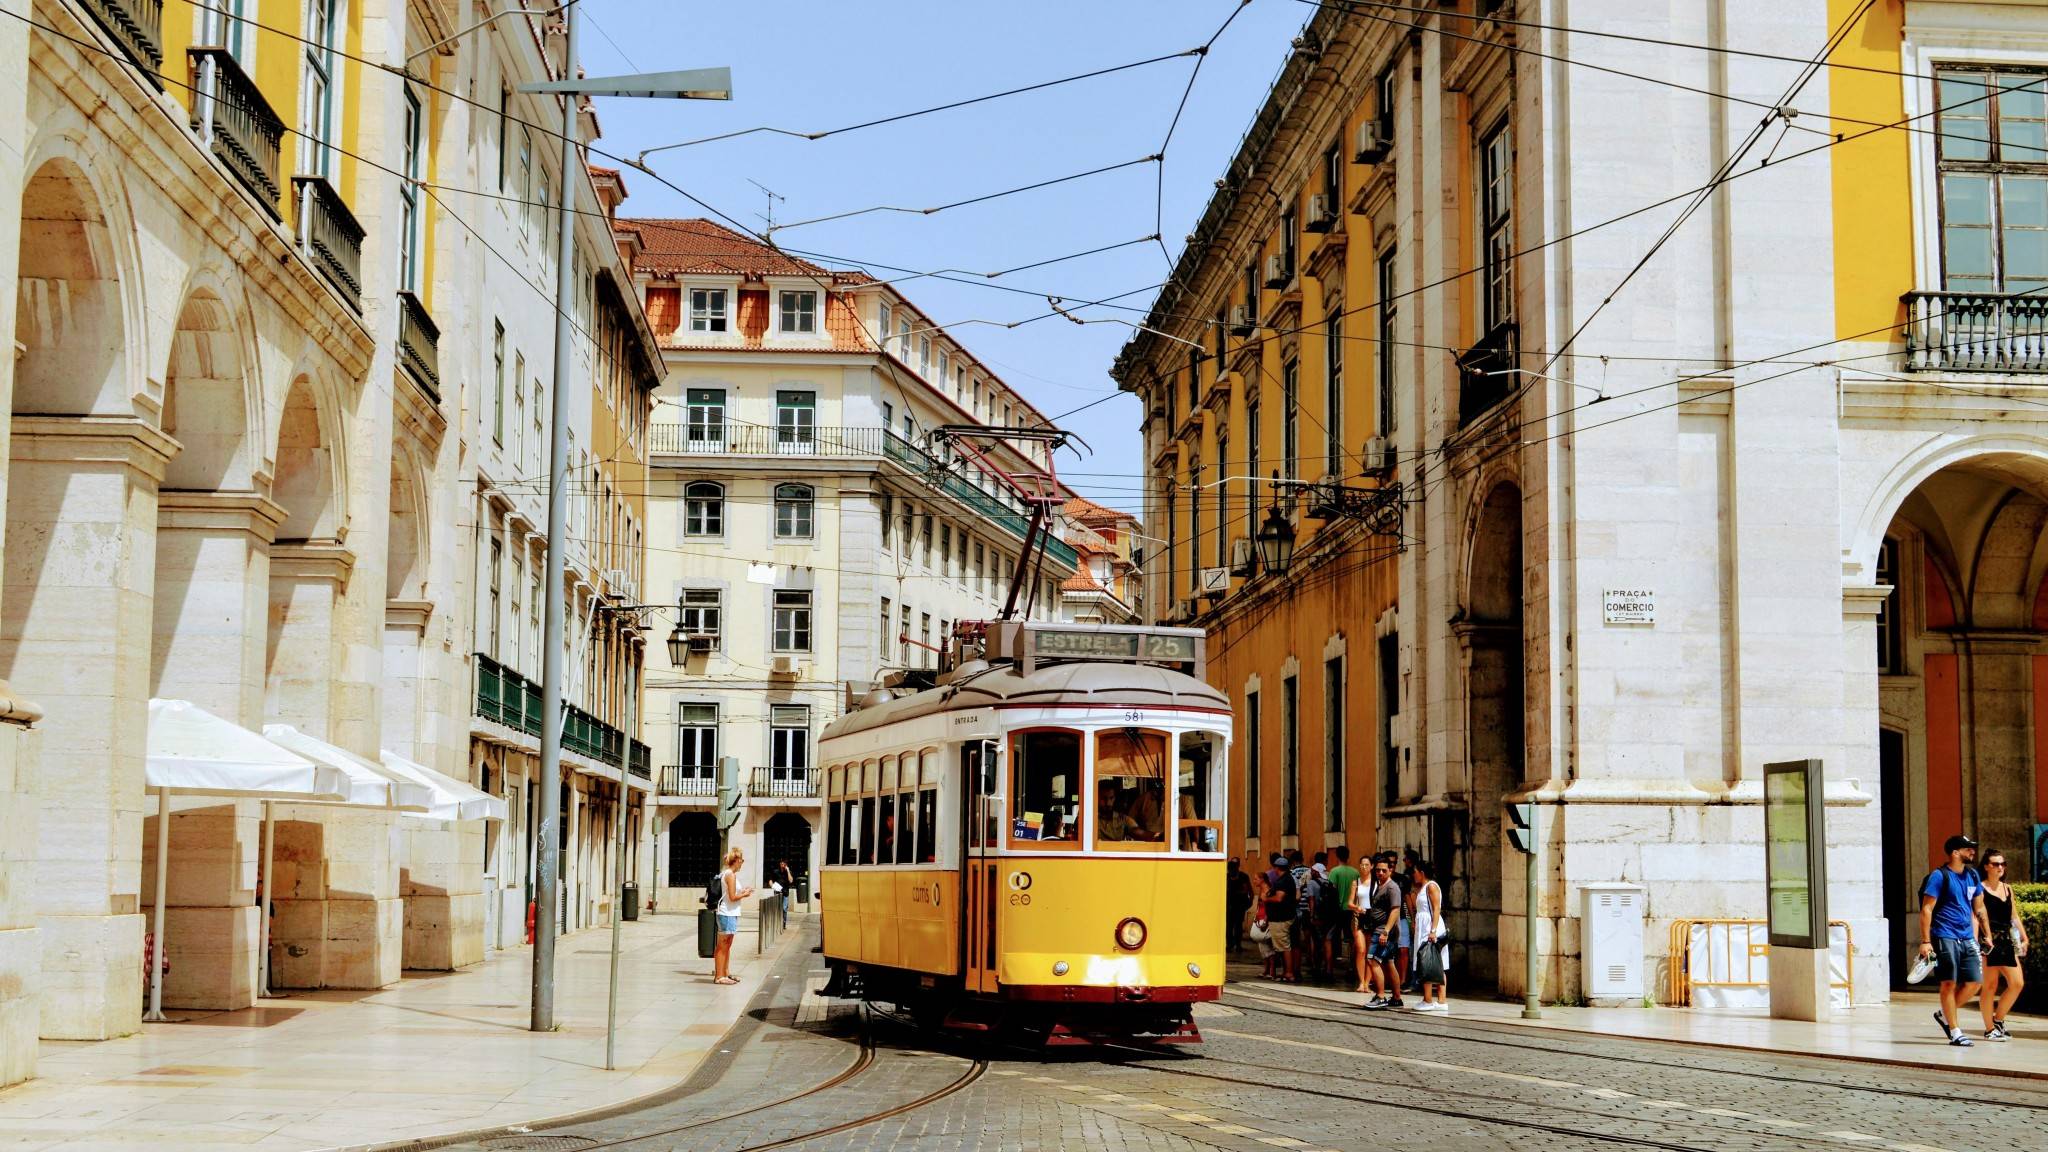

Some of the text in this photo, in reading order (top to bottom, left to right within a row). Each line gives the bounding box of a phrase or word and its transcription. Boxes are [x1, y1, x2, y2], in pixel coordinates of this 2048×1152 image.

[1613, 590, 1647, 598] PRAÇA
[1606, 603, 1654, 612] COMERCIO
[1041, 633, 1130, 651] ESTRELA
[1150, 636, 1180, 656] 25
[1125, 711, 1144, 721] 581
[1014, 829, 1024, 837] 01
